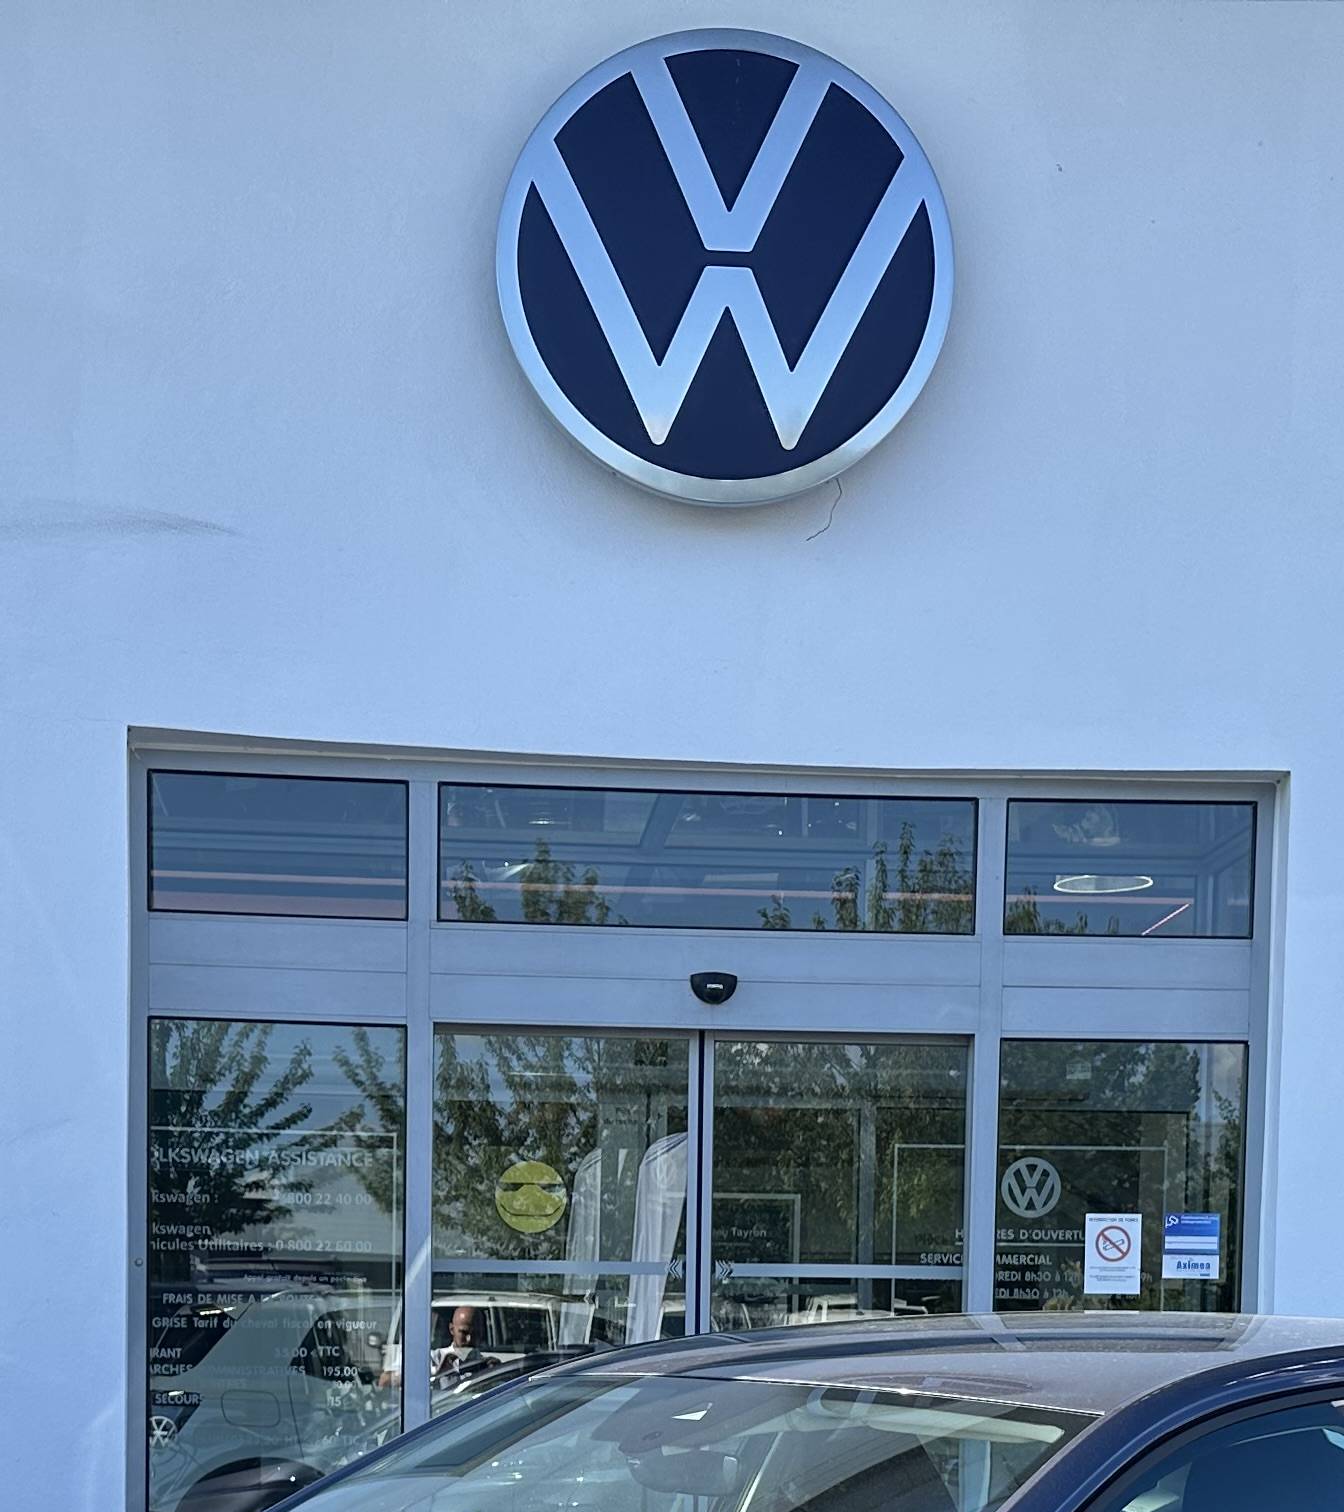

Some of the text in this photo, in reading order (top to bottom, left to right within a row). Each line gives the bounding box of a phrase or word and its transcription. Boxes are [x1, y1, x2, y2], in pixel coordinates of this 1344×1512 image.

[268, 1150, 373, 1168] ASSISTANCE
[356, 1193, 373, 1206] 00
[152, 1221, 212, 1237] kswagen
[198, 1238, 264, 1251] Utilitaires
[287, 1239, 312, 1251] 800
[316, 1240, 332, 1252] 22
[356, 1240, 373, 1252] 00
[162, 1293, 193, 1305] FRAIS
[198, 1293, 212, 1304] DE
[217, 1293, 244, 1305] MISE
[152, 1317, 188, 1328] GRISE
[193, 1317, 218, 1328] Tarif
[335, 1317, 377, 1331] vigueur
[151, 1347, 183, 1359] RANT
